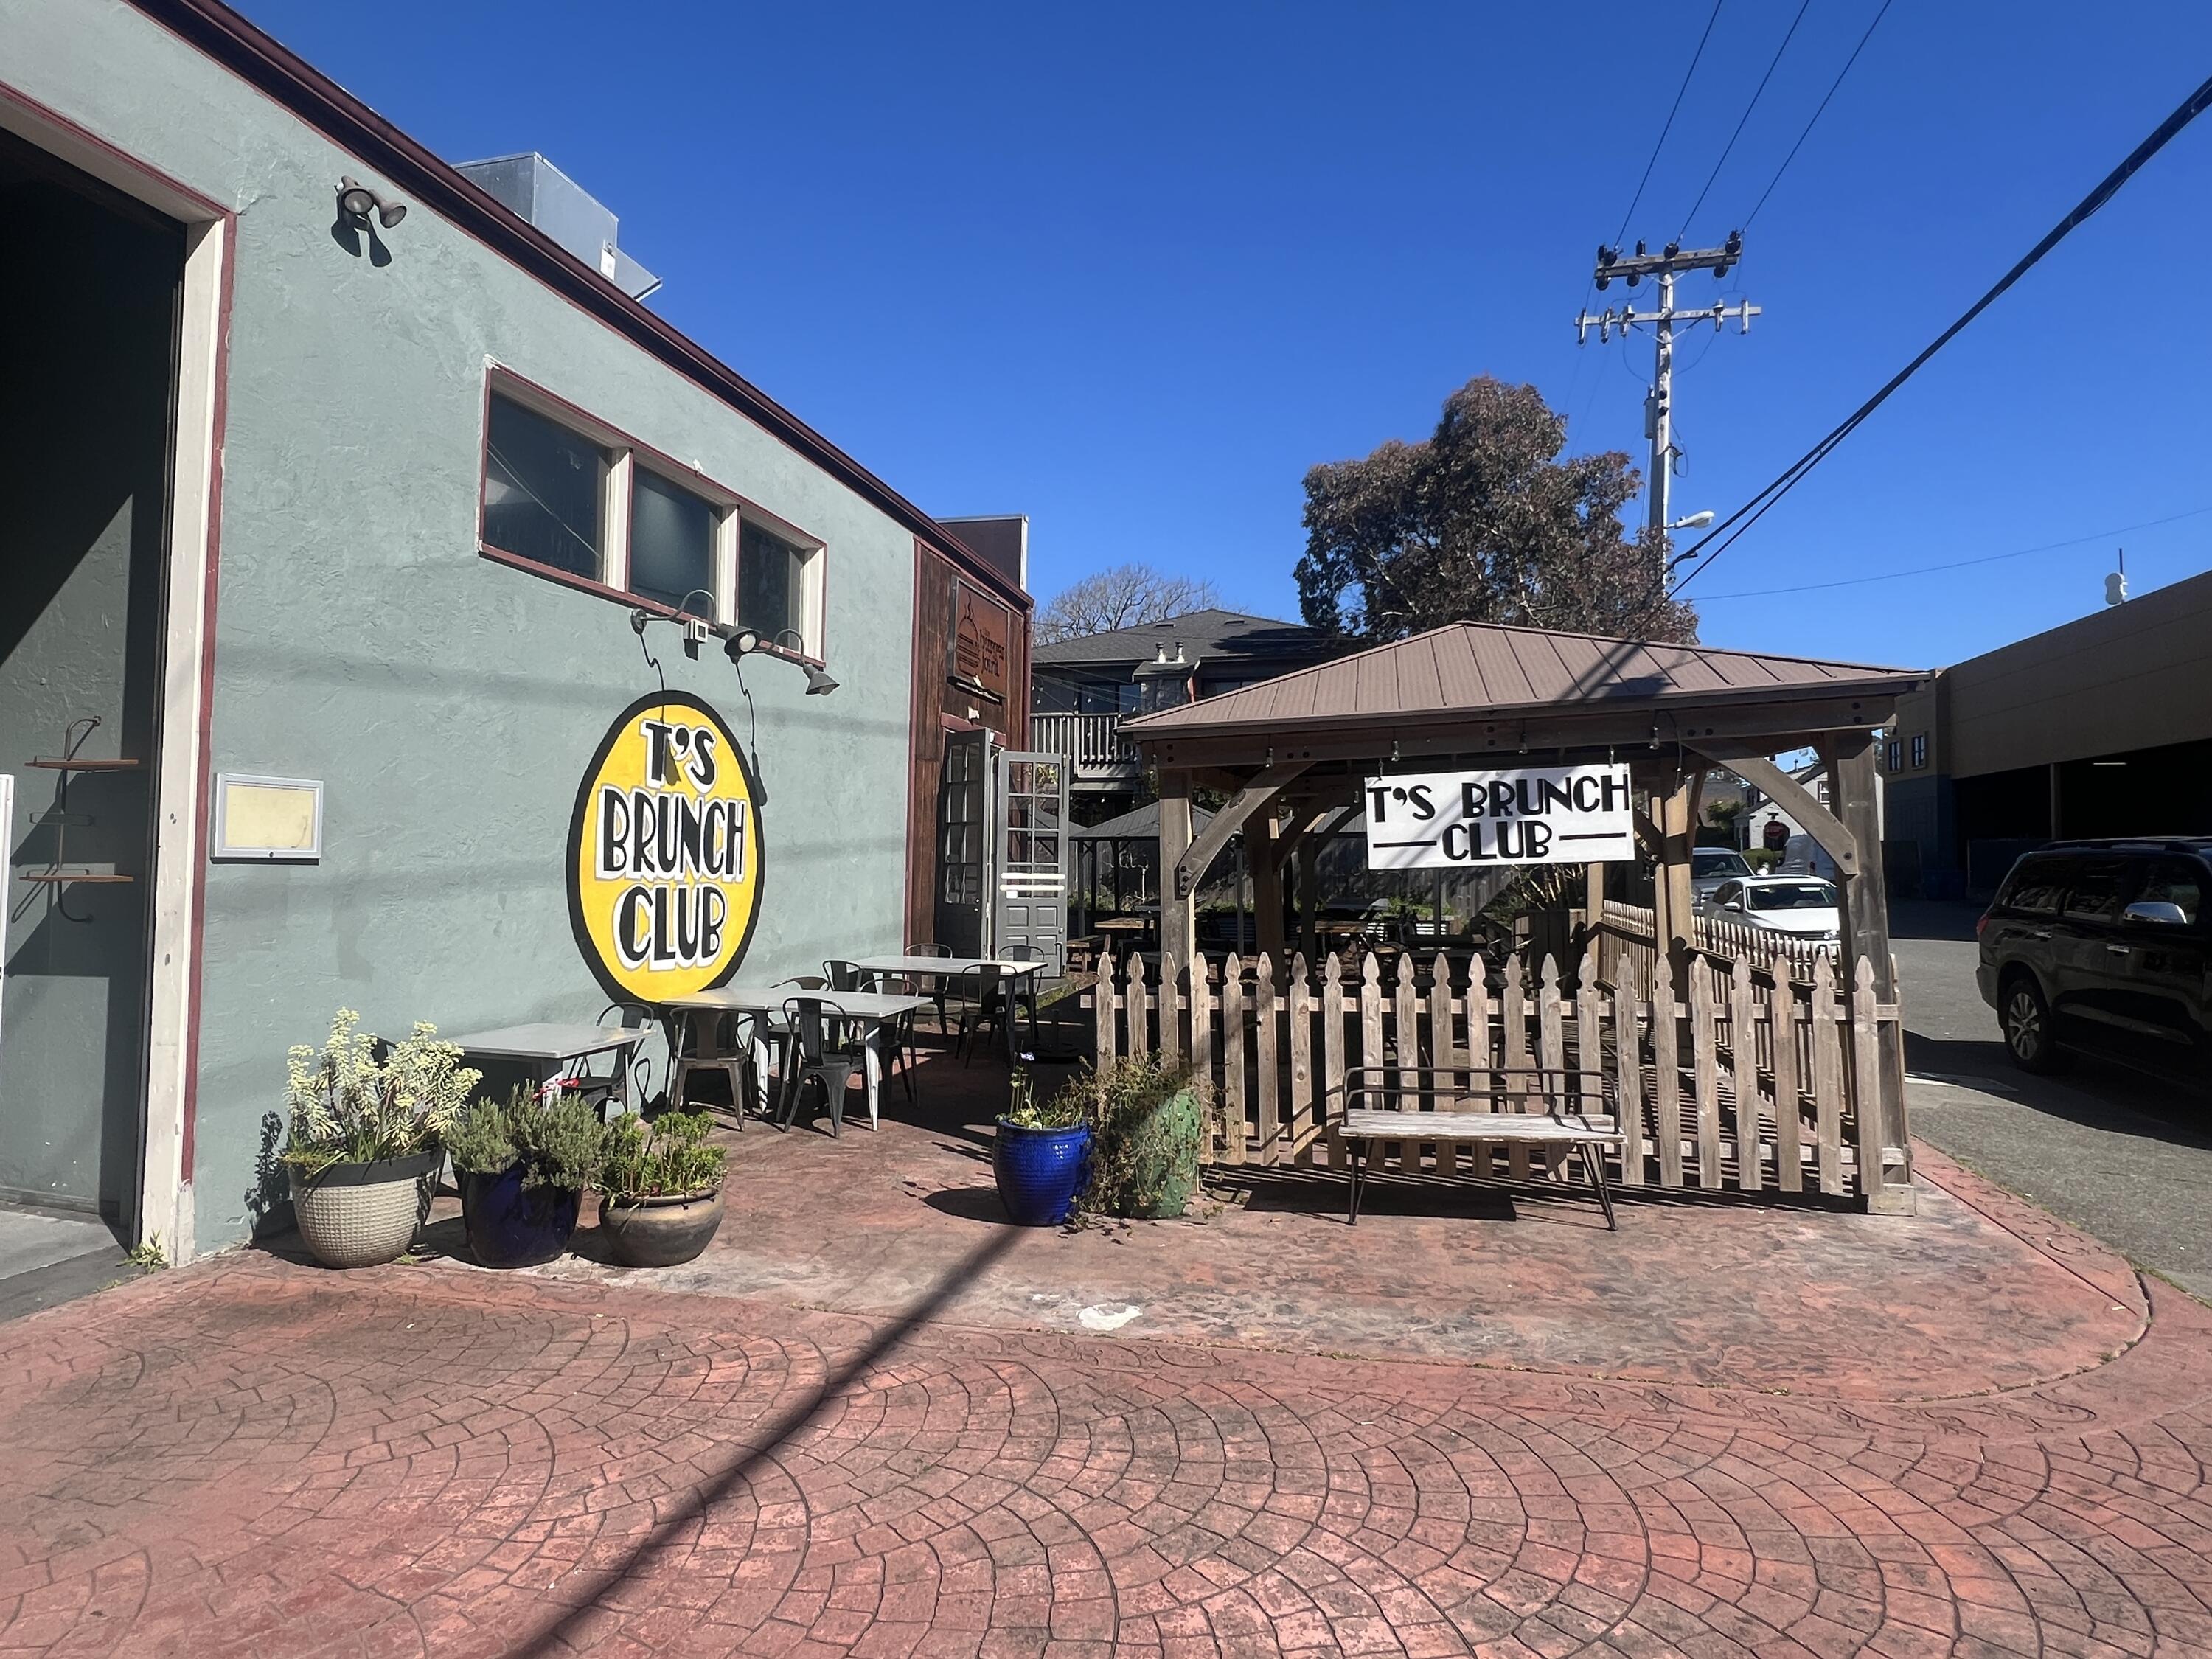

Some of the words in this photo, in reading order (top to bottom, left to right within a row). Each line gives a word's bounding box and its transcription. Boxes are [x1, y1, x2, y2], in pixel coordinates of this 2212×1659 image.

[644, 722, 714, 785] T'S
[1367, 785, 1434, 823] T'S
[1461, 773, 1630, 818] BRUNCH
[603, 789, 744, 875] BRUNCH
[1442, 820, 1552, 860] CLUB
[619, 886, 725, 961] CLUB
